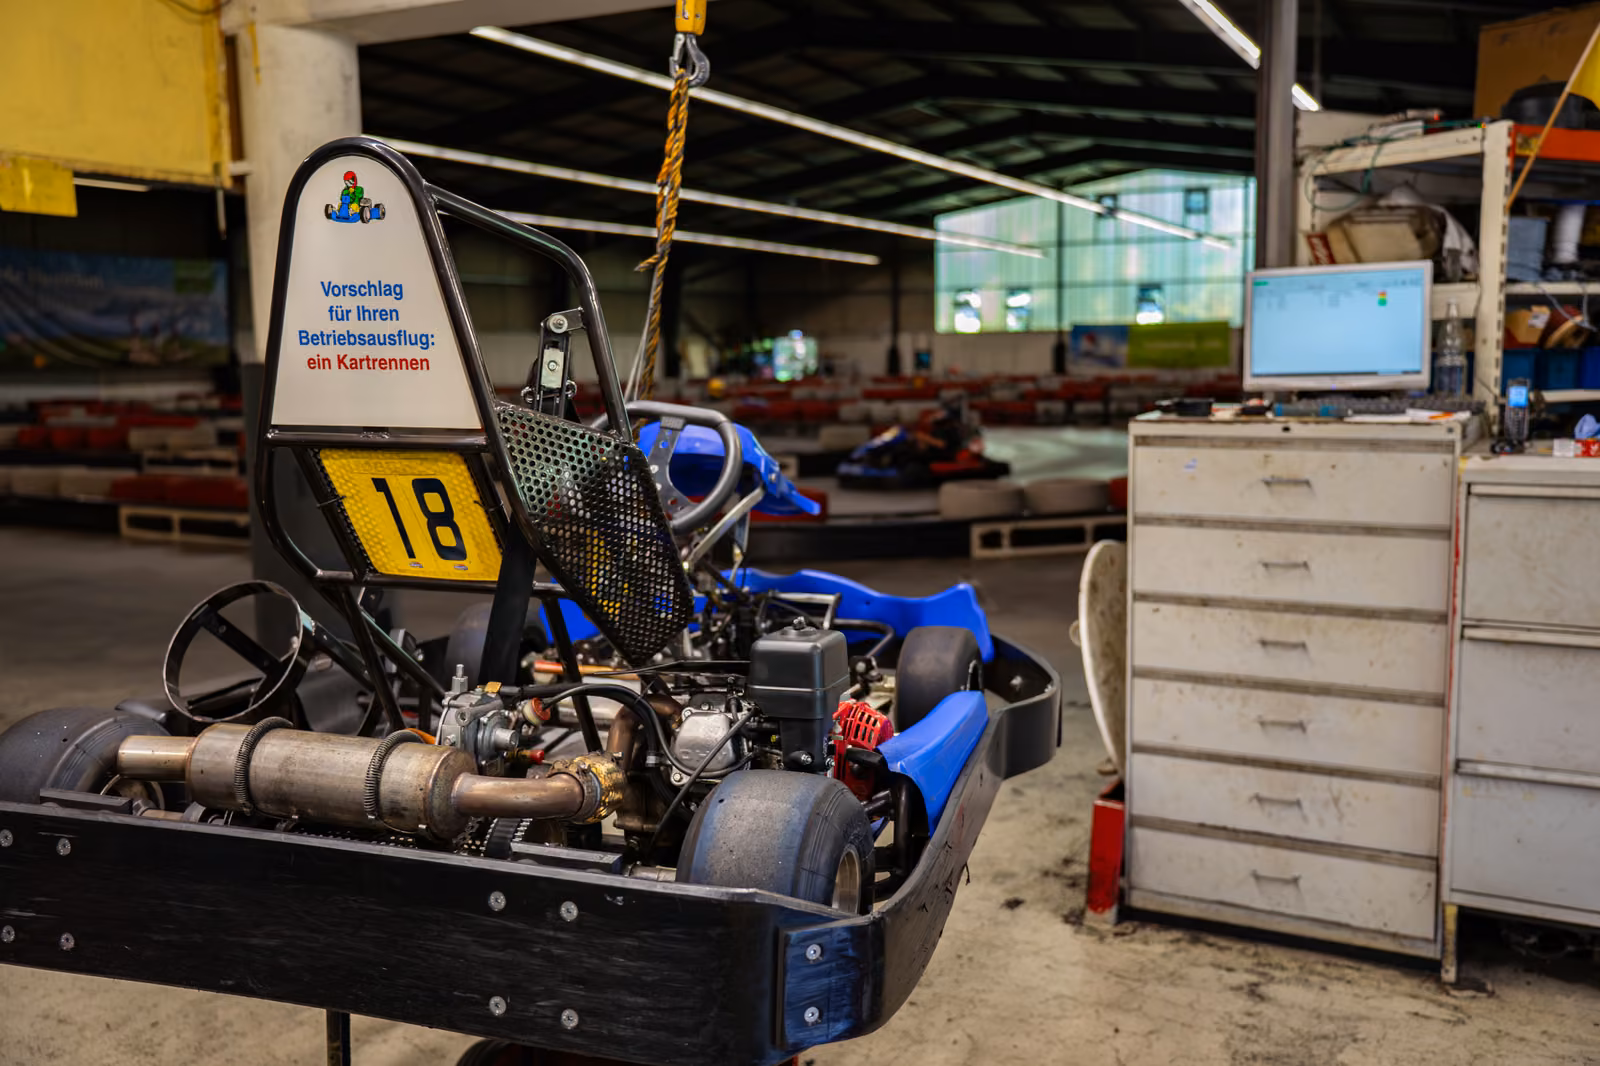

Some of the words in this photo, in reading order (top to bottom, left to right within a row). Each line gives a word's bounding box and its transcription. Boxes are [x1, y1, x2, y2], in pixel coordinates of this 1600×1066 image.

[320, 280, 404, 300] Vorschlag
[328, 305, 353, 322] für
[356, 305, 400, 322] Ihren
[298, 329, 436, 350] Betriebsausflug:
[307, 354, 332, 371] ein
[337, 354, 431, 371] Kartrennen
[371, 477, 468, 561] 18
